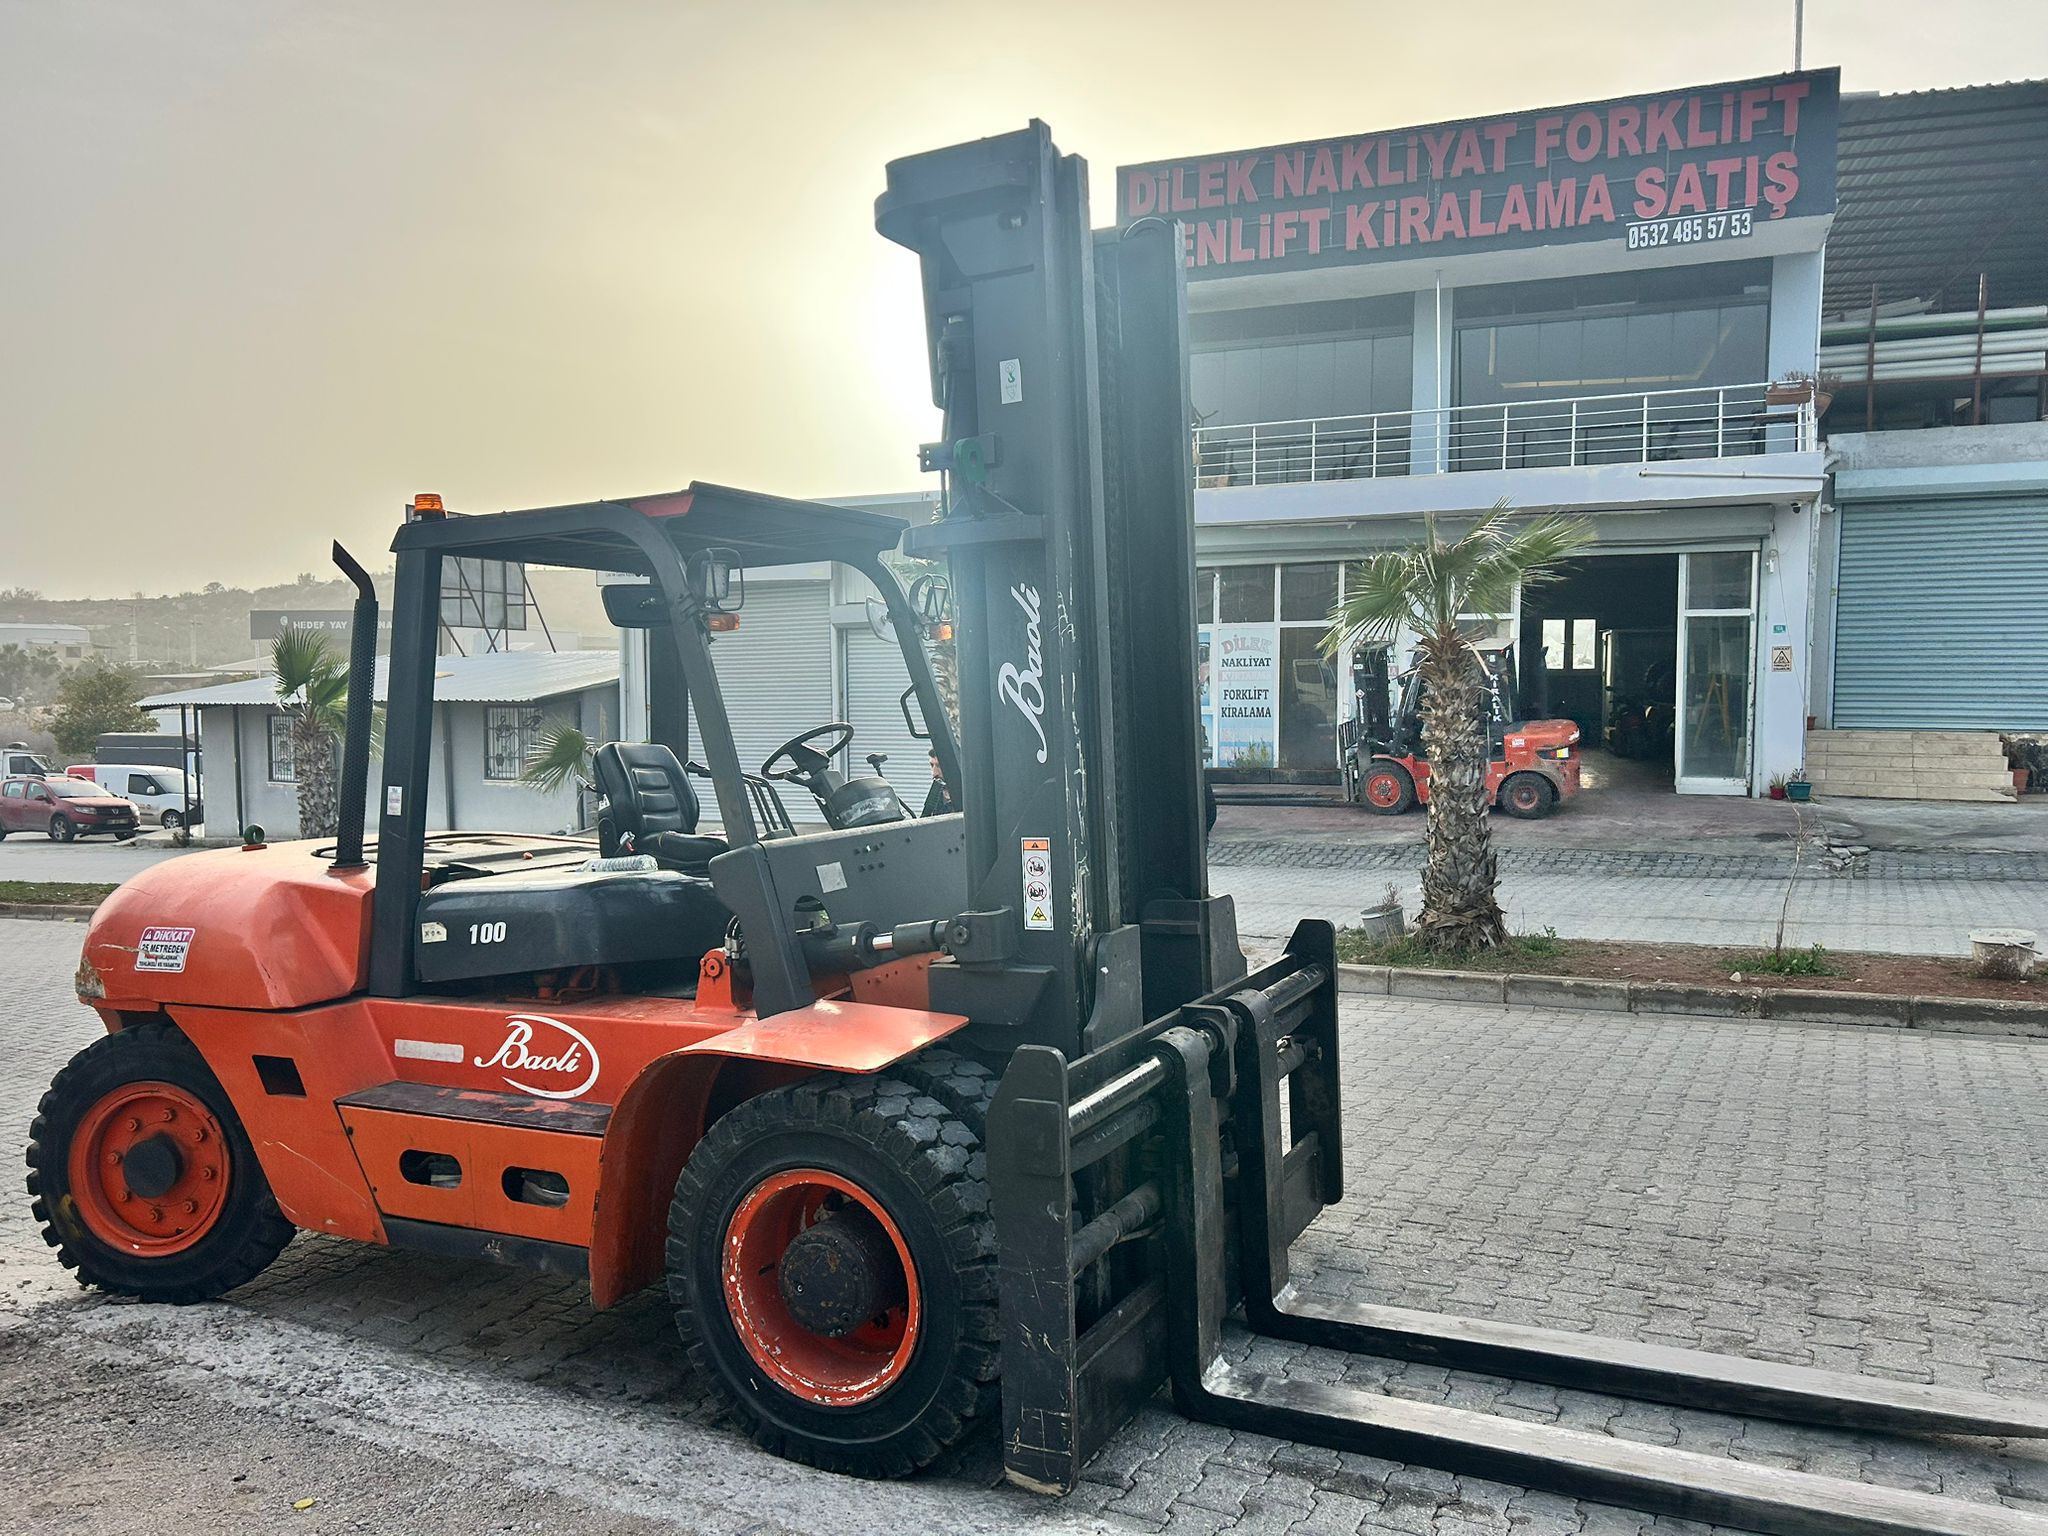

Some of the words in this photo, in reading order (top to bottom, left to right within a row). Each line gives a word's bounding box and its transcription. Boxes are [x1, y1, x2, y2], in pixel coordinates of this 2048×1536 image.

[1632, 151, 1799, 220] SATIŞ
[1628, 222, 1669, 249] 0532
[1672, 218, 1703, 243] 485
[1707, 215, 1727, 239] 57
[1731, 212, 1751, 236] 53
[293, 621, 325, 630] HEDEF
[329, 621, 348, 630] YAY
[1221, 655, 1272, 667] NAKLİYAT
[998, 583, 1047, 763] Baoli
[1223, 686, 1270, 700] FORKLİFT
[1221, 704, 1272, 718] KİRALAMA
[469, 921, 507, 945] 100
[150, 945, 186, 953] METREDEN
[473, 1020, 582, 1073] Baoli
